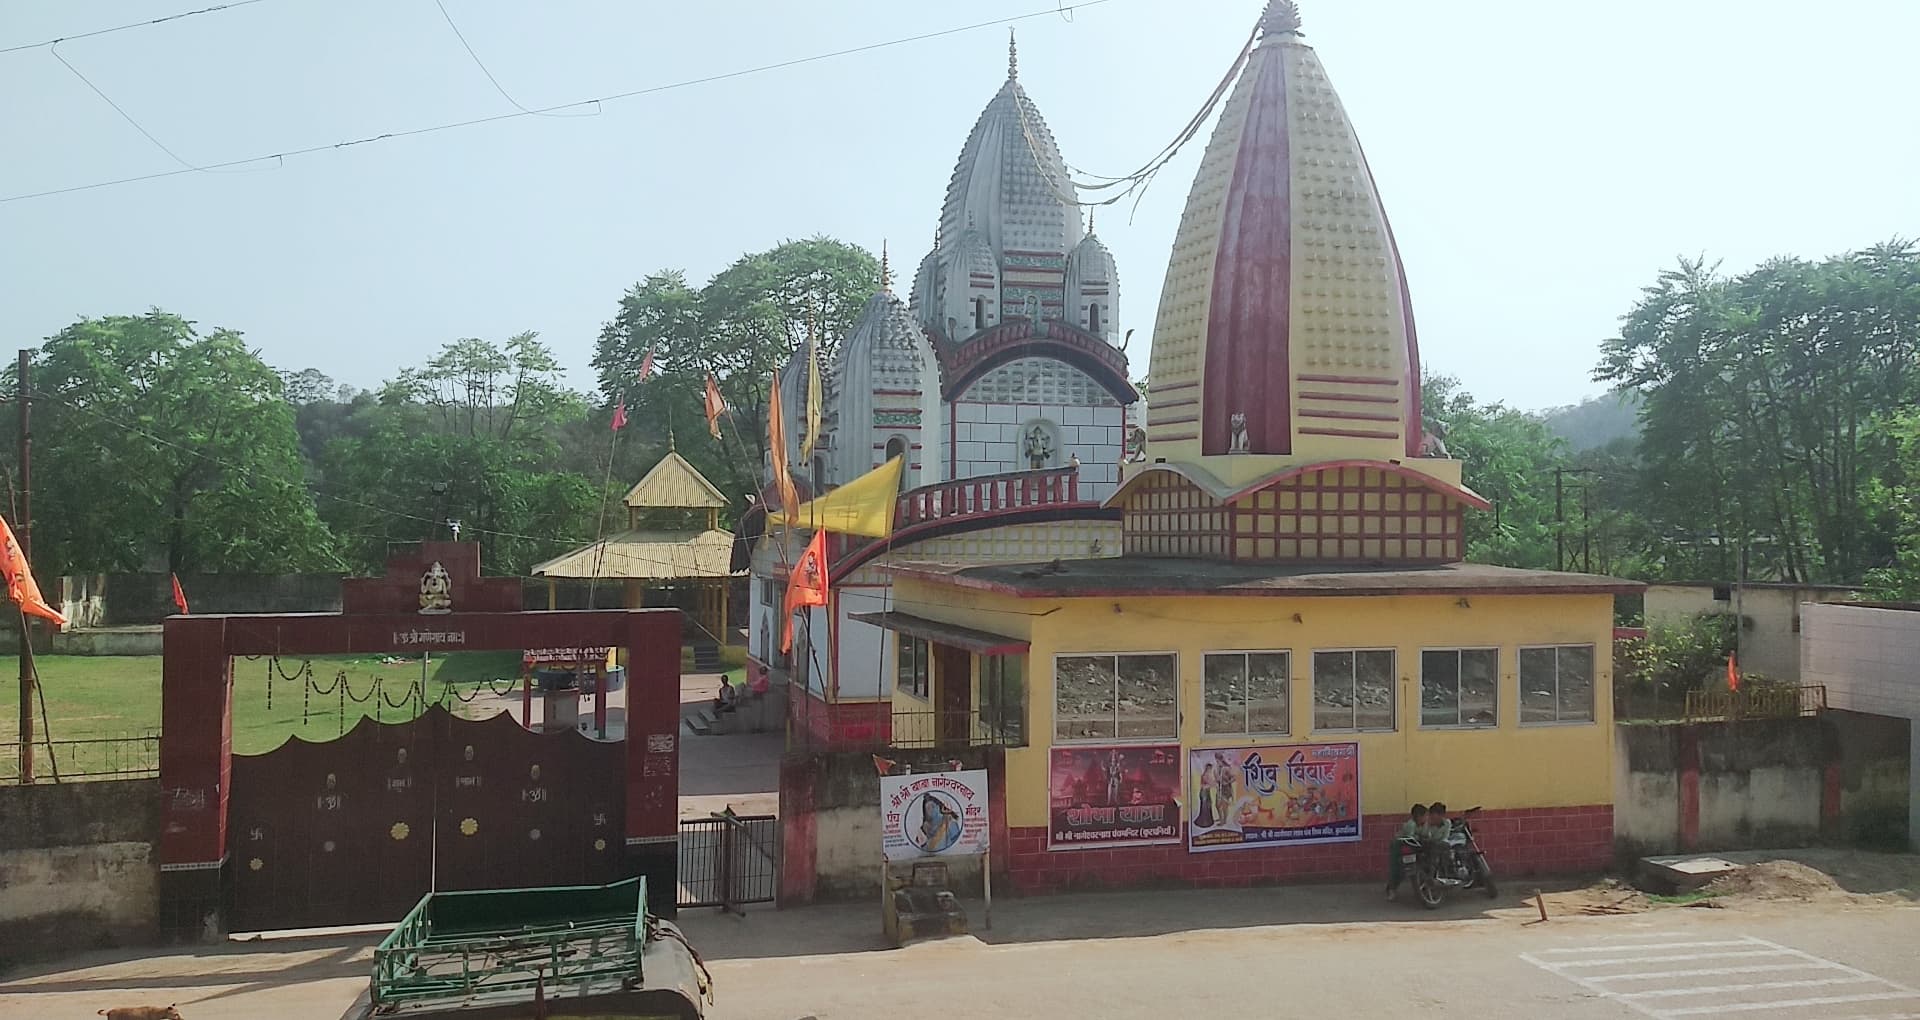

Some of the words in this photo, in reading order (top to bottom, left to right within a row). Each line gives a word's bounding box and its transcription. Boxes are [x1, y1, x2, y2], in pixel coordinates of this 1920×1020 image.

[1241, 752, 1280, 796] शिव
[1286, 750, 1336, 787] विवाह
[890, 794, 903, 809] श्री
[899, 785, 911, 800] श्री
[910, 778, 929, 792] बाबा
[886, 810, 900, 822] पंच
[1067, 803, 1116, 826] शोभा
[1119, 804, 1165, 823] यात्रा
